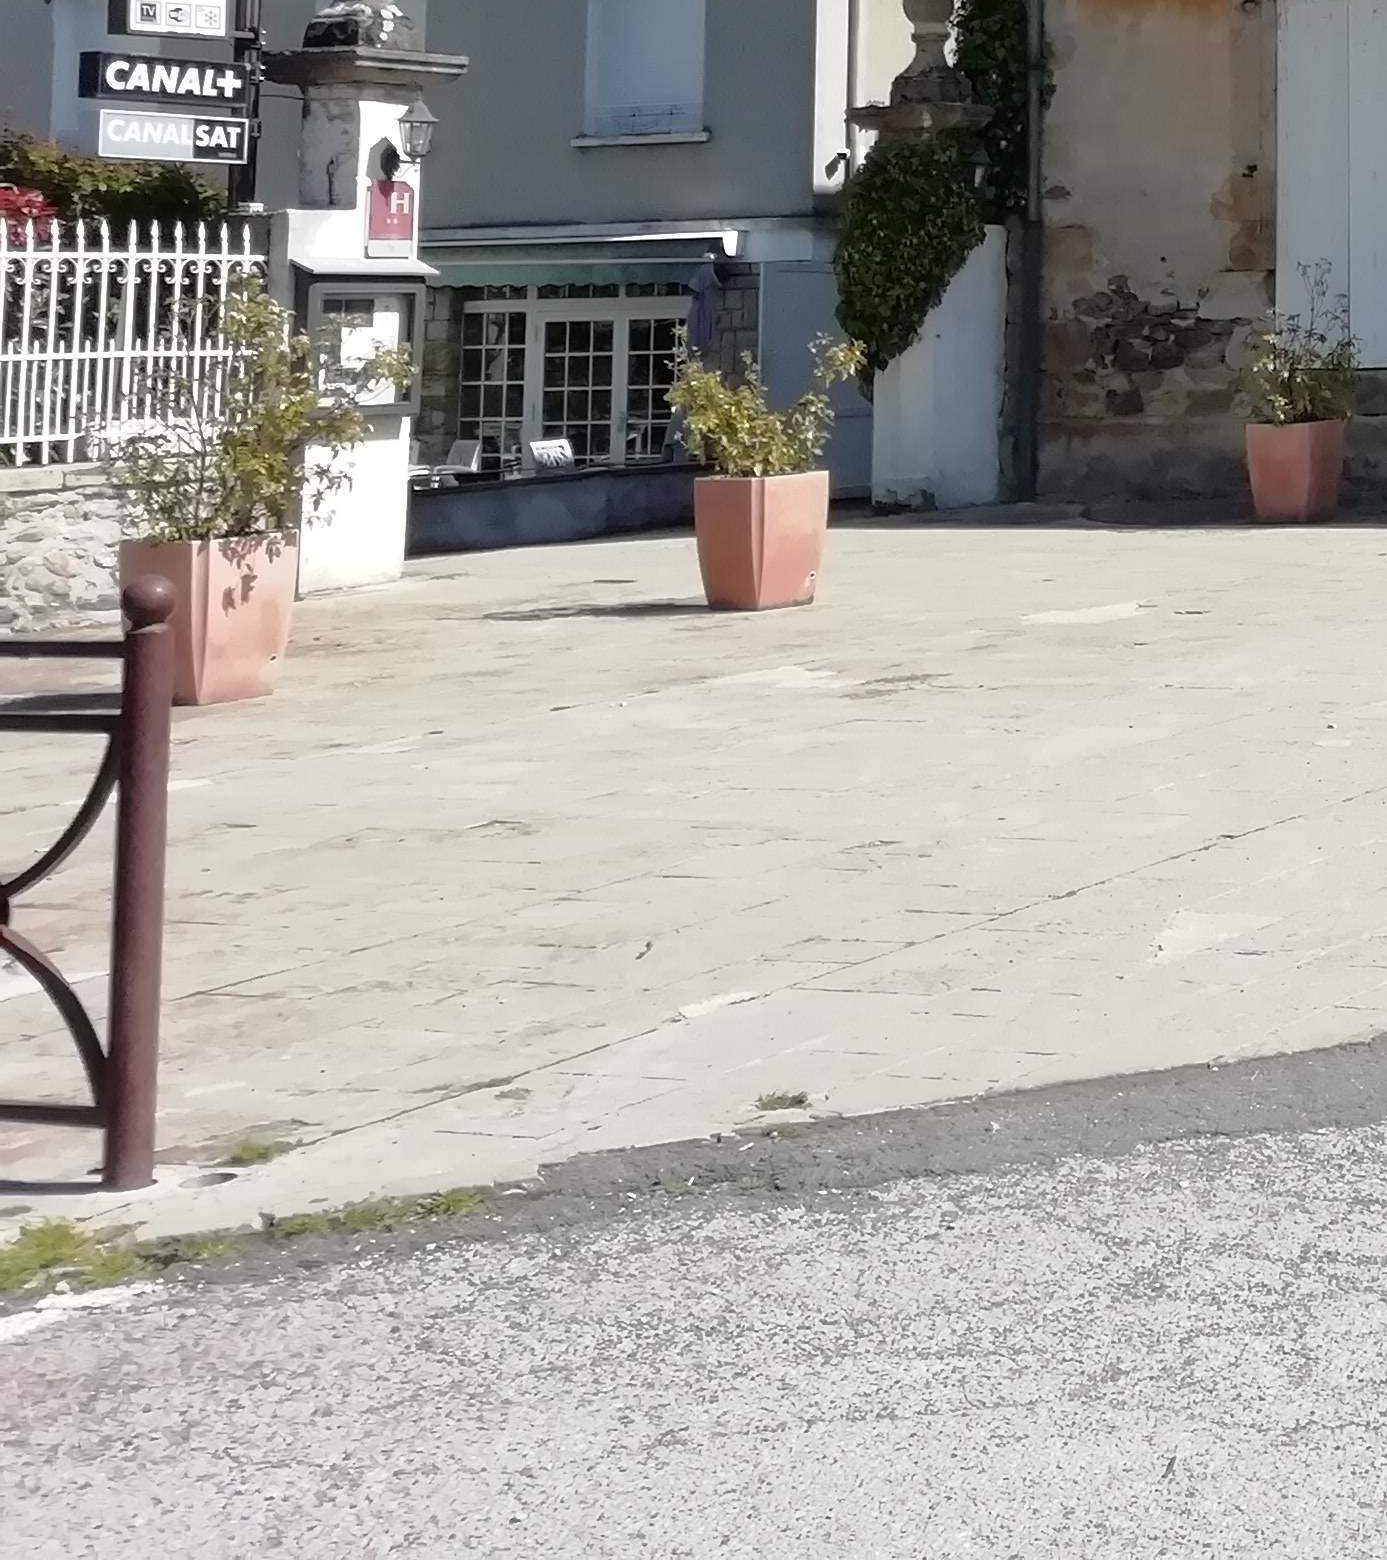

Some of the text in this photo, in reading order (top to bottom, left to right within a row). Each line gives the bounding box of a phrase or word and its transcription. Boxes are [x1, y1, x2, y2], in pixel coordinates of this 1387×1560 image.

[141, 5, 156, 16] TV
[105, 60, 242, 98] CANAL+
[389, 191, 411, 215] H
